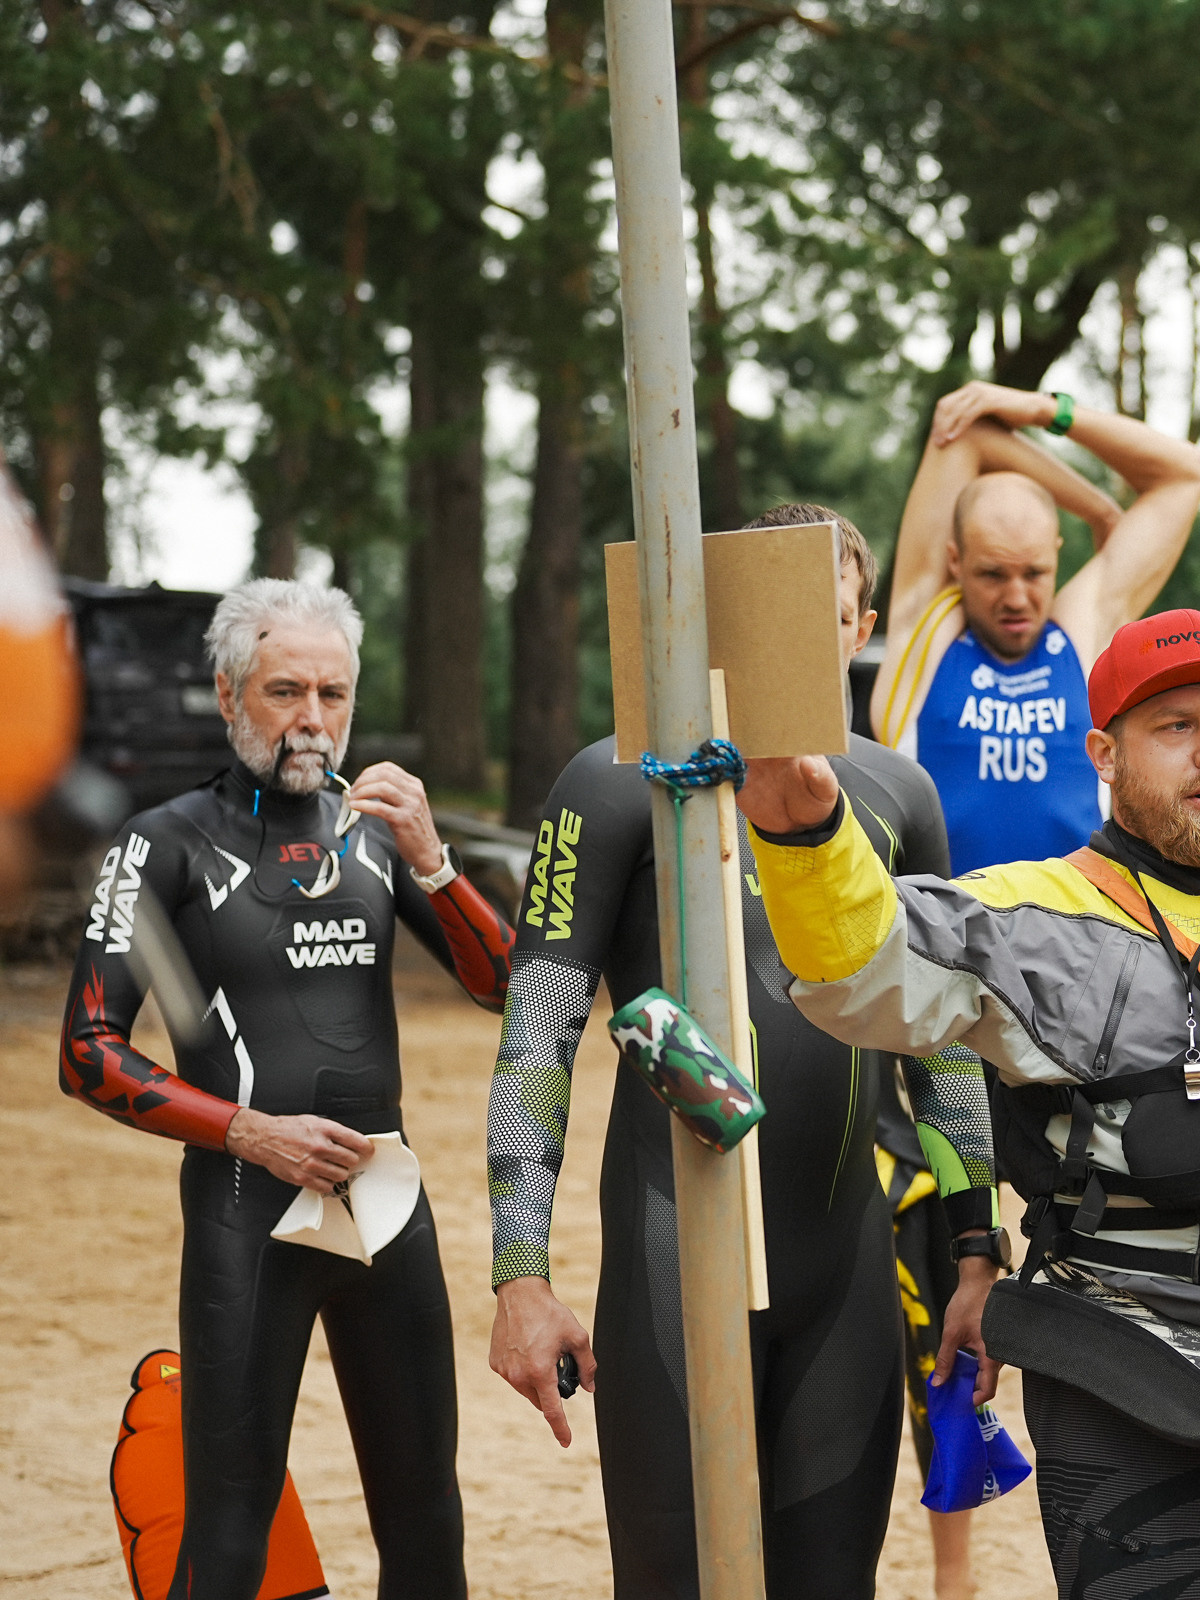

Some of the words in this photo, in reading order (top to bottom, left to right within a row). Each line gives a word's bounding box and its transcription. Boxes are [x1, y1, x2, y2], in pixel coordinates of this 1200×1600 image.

[958, 695, 1067, 735] ASTAFEV
[978, 735, 1048, 783] RUS
[279, 843, 322, 863] JET
[526, 819, 554, 928] MAD
[545, 807, 583, 941] WAVE
[86, 846, 121, 942] MAD
[105, 832, 151, 953] WAVE
[293, 918, 367, 944] MAD
[285, 943, 376, 969] WAVE
